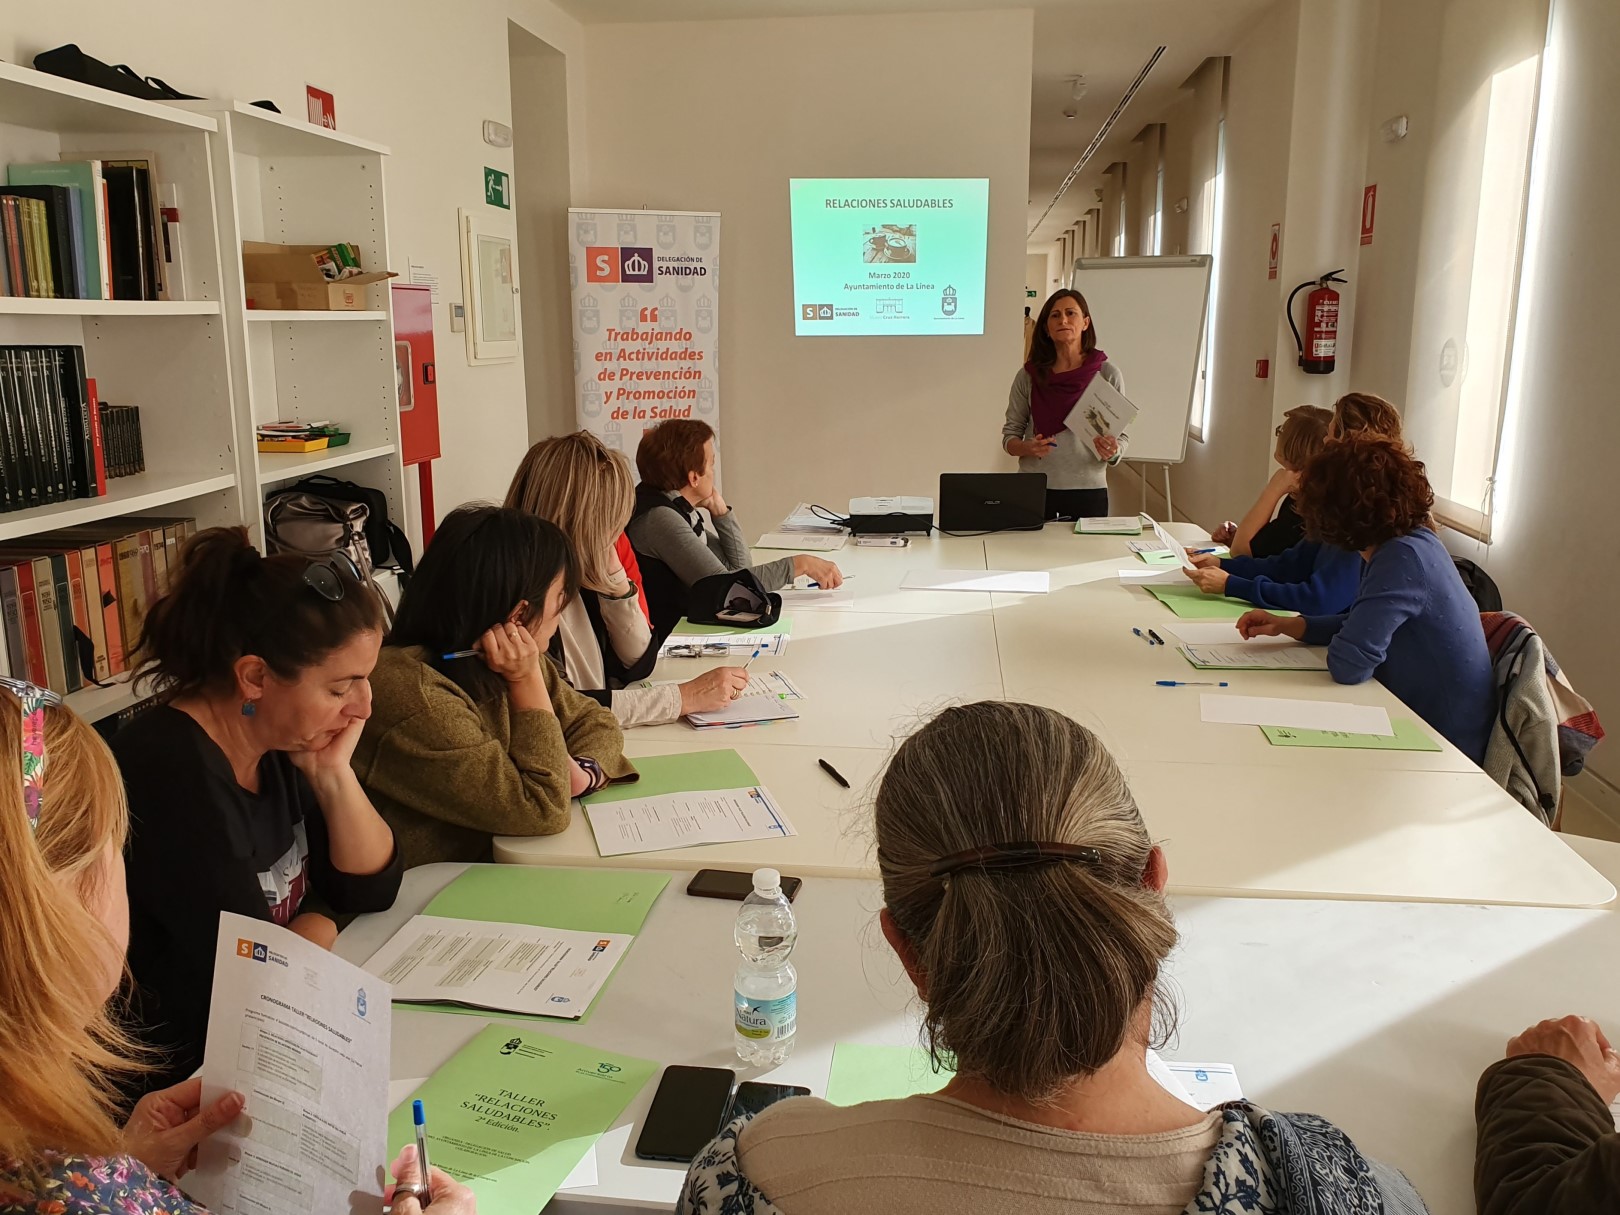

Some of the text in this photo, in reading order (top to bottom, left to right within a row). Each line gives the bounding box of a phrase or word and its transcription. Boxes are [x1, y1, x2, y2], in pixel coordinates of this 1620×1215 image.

[825, 198, 954, 209] RELACIONES SALUDABLES
[657, 266, 707, 276] SANIDAD
[892, 271, 911, 279] 2020
[844, 283, 895, 291] Ayuntamiento
[606, 328, 693, 345] Trabajando
[594, 347, 704, 362] en Actividades
[597, 367, 702, 382] de Prevención
[604, 386, 697, 404] y Promoción
[611, 405, 692, 420] de la Salud
[268, 956, 288, 967] SANIDAD
[260, 994, 291, 1010] CRONOGRAMA
[498, 1088, 546, 1107] TALLER
[474, 1093, 558, 1120] “RELACIONES
[485, 1118, 520, 1133] Edición.
